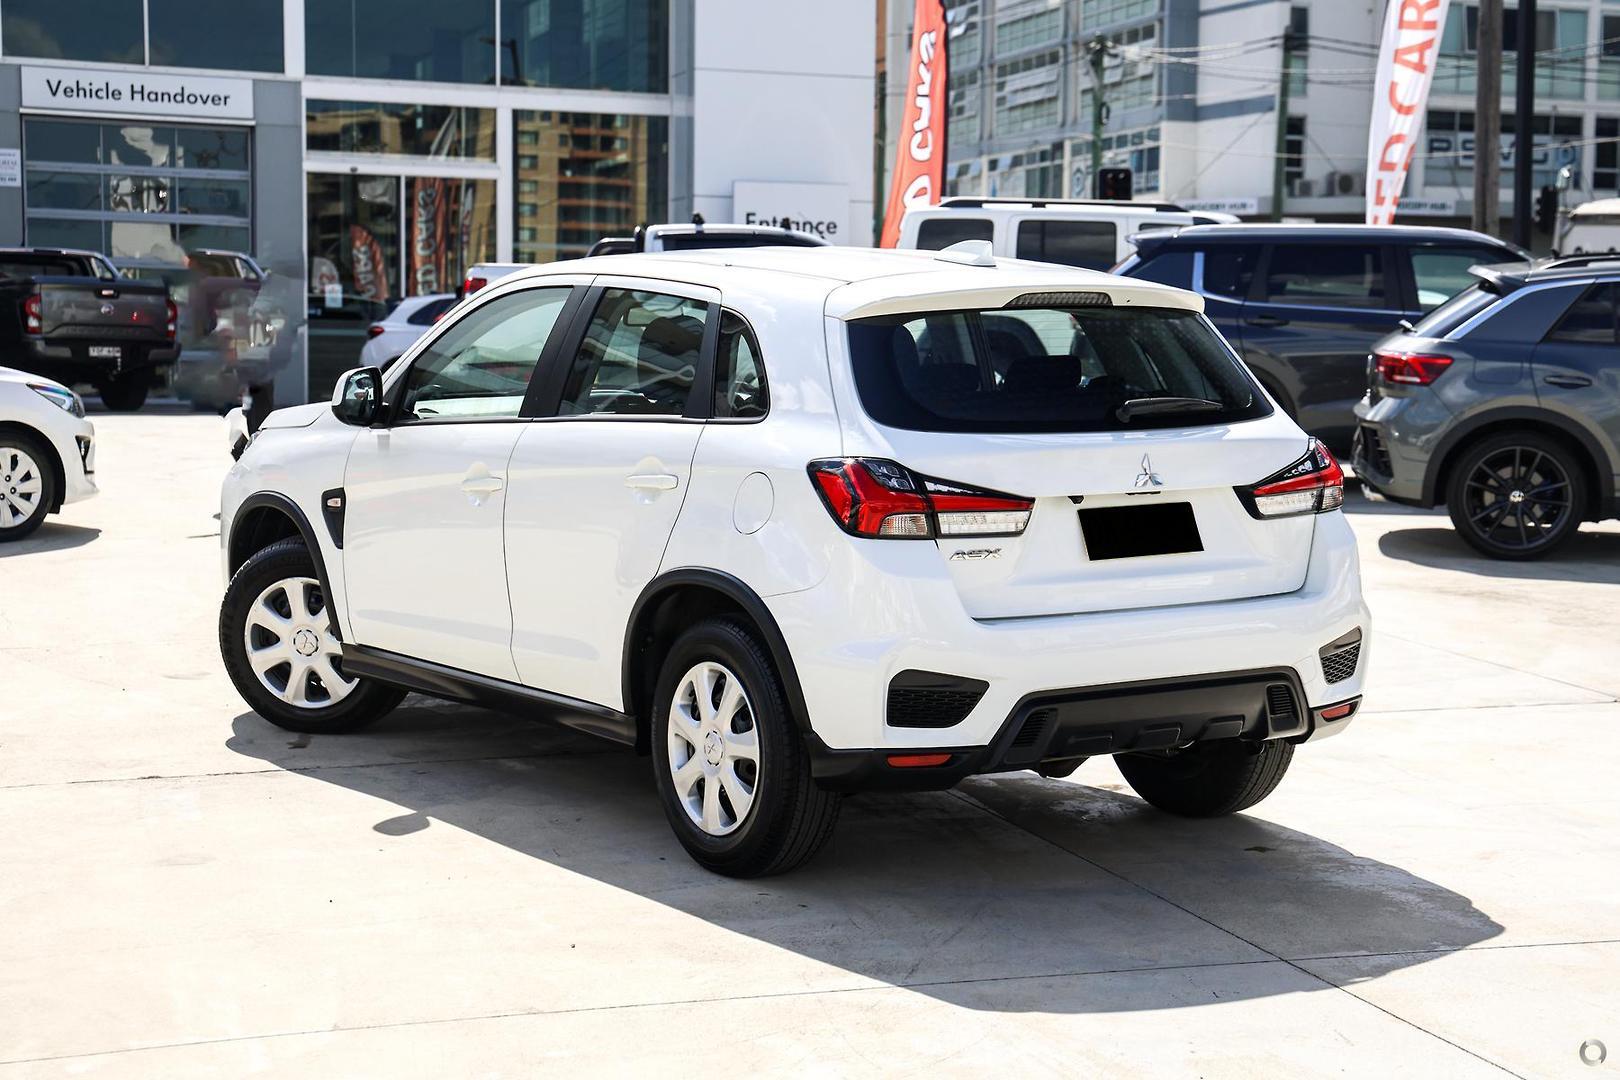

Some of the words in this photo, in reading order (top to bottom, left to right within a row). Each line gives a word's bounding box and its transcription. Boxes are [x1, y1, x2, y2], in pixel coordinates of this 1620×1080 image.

[46, 79, 122, 101] Vehicle
[130, 83, 231, 107] Handover
[745, 212, 838, 235] Entance
